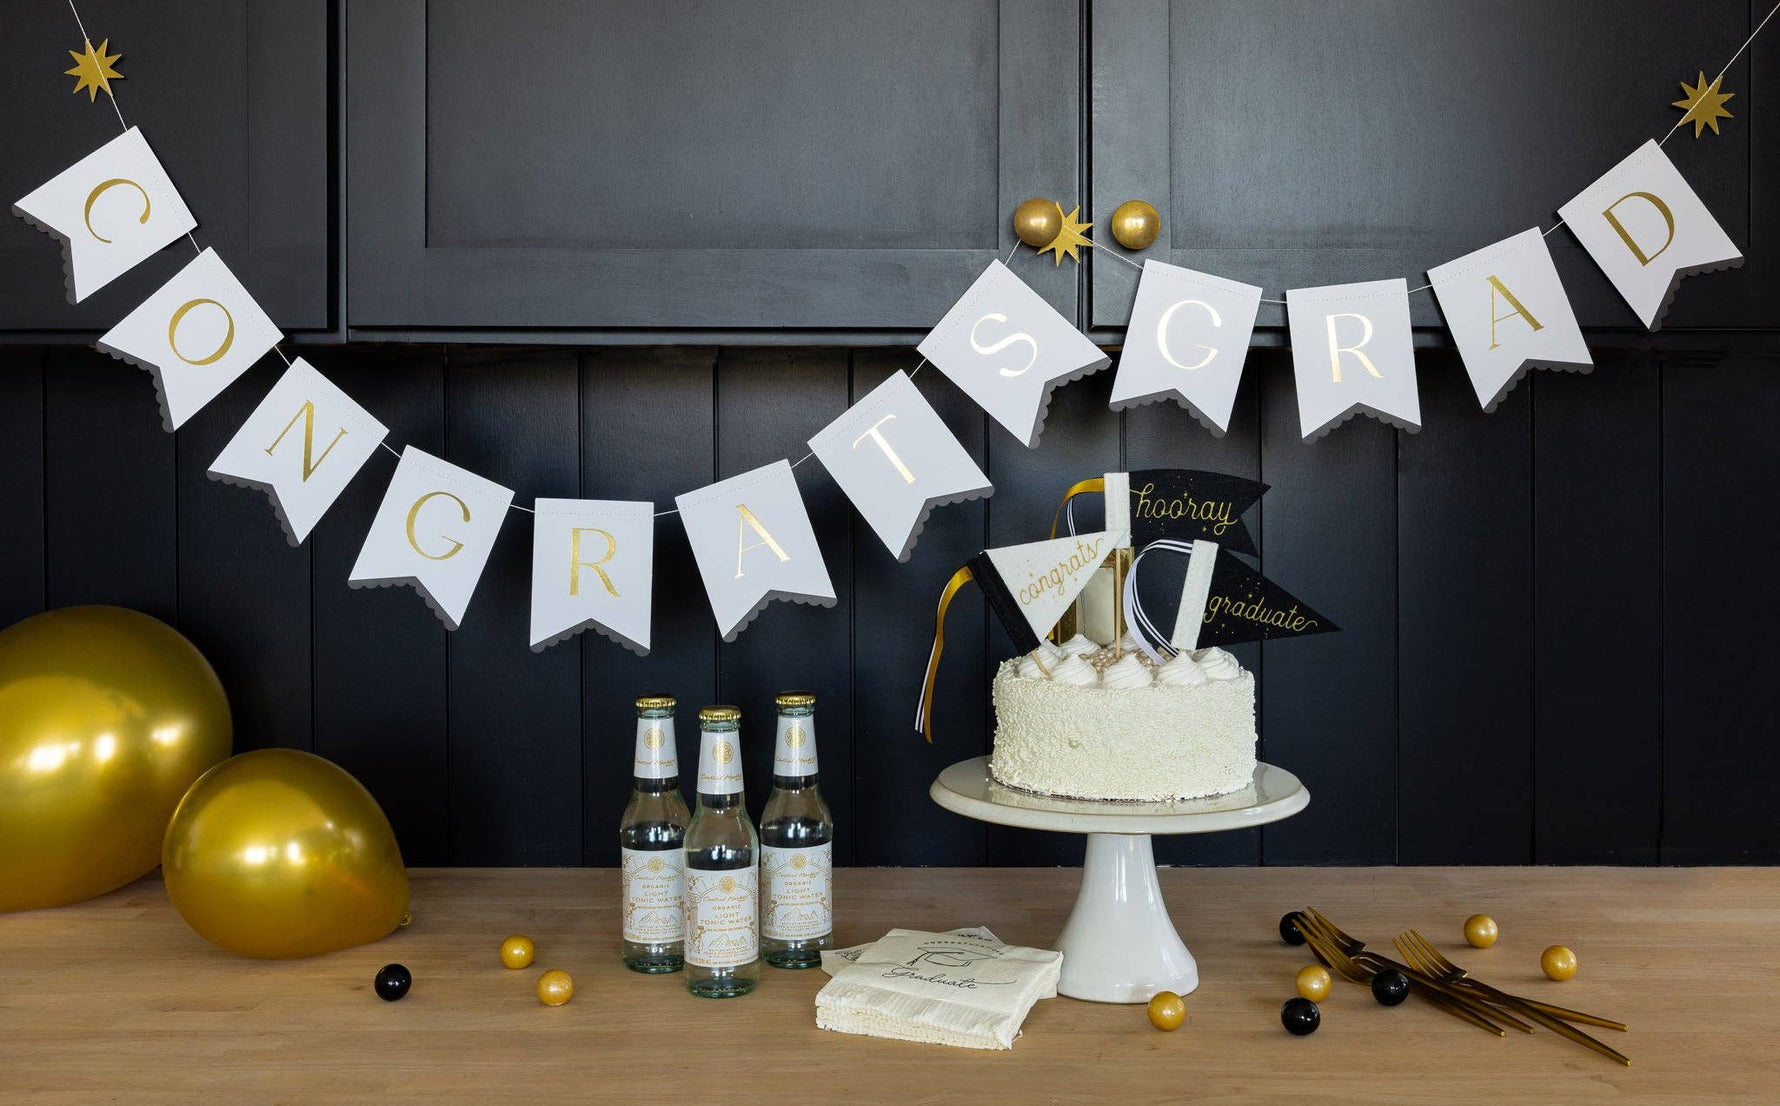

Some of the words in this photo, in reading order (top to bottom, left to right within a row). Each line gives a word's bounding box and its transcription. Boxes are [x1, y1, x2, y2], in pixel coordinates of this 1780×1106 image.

[1156, 191, 1675, 383] GRAD
[1129, 483, 1238, 535] hooray
[1019, 538, 1104, 605] congrats
[1203, 595, 1317, 631] graduate
[657, 895, 682, 903] WATER
[799, 891, 823, 899] WATER
[728, 915, 751, 924] WATER
